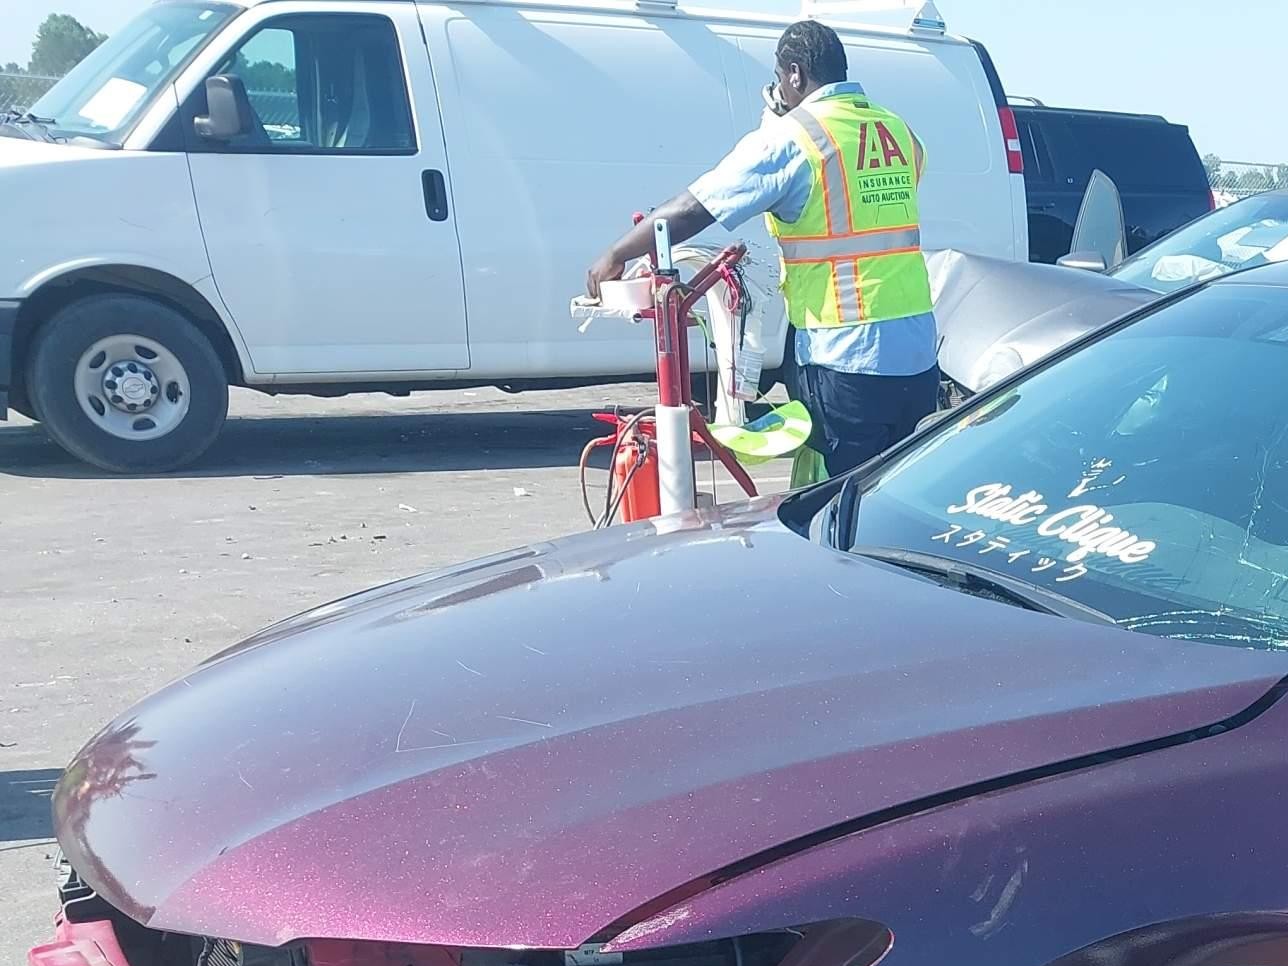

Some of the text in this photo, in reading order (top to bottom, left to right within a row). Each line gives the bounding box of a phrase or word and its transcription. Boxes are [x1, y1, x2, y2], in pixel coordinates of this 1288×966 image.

[859, 175, 911, 190] INSURANCE
[861, 191, 911, 204] AUTO AUCTION
[947, 482, 1157, 564] Static Clique
[931, 523, 1088, 582] スタティック
